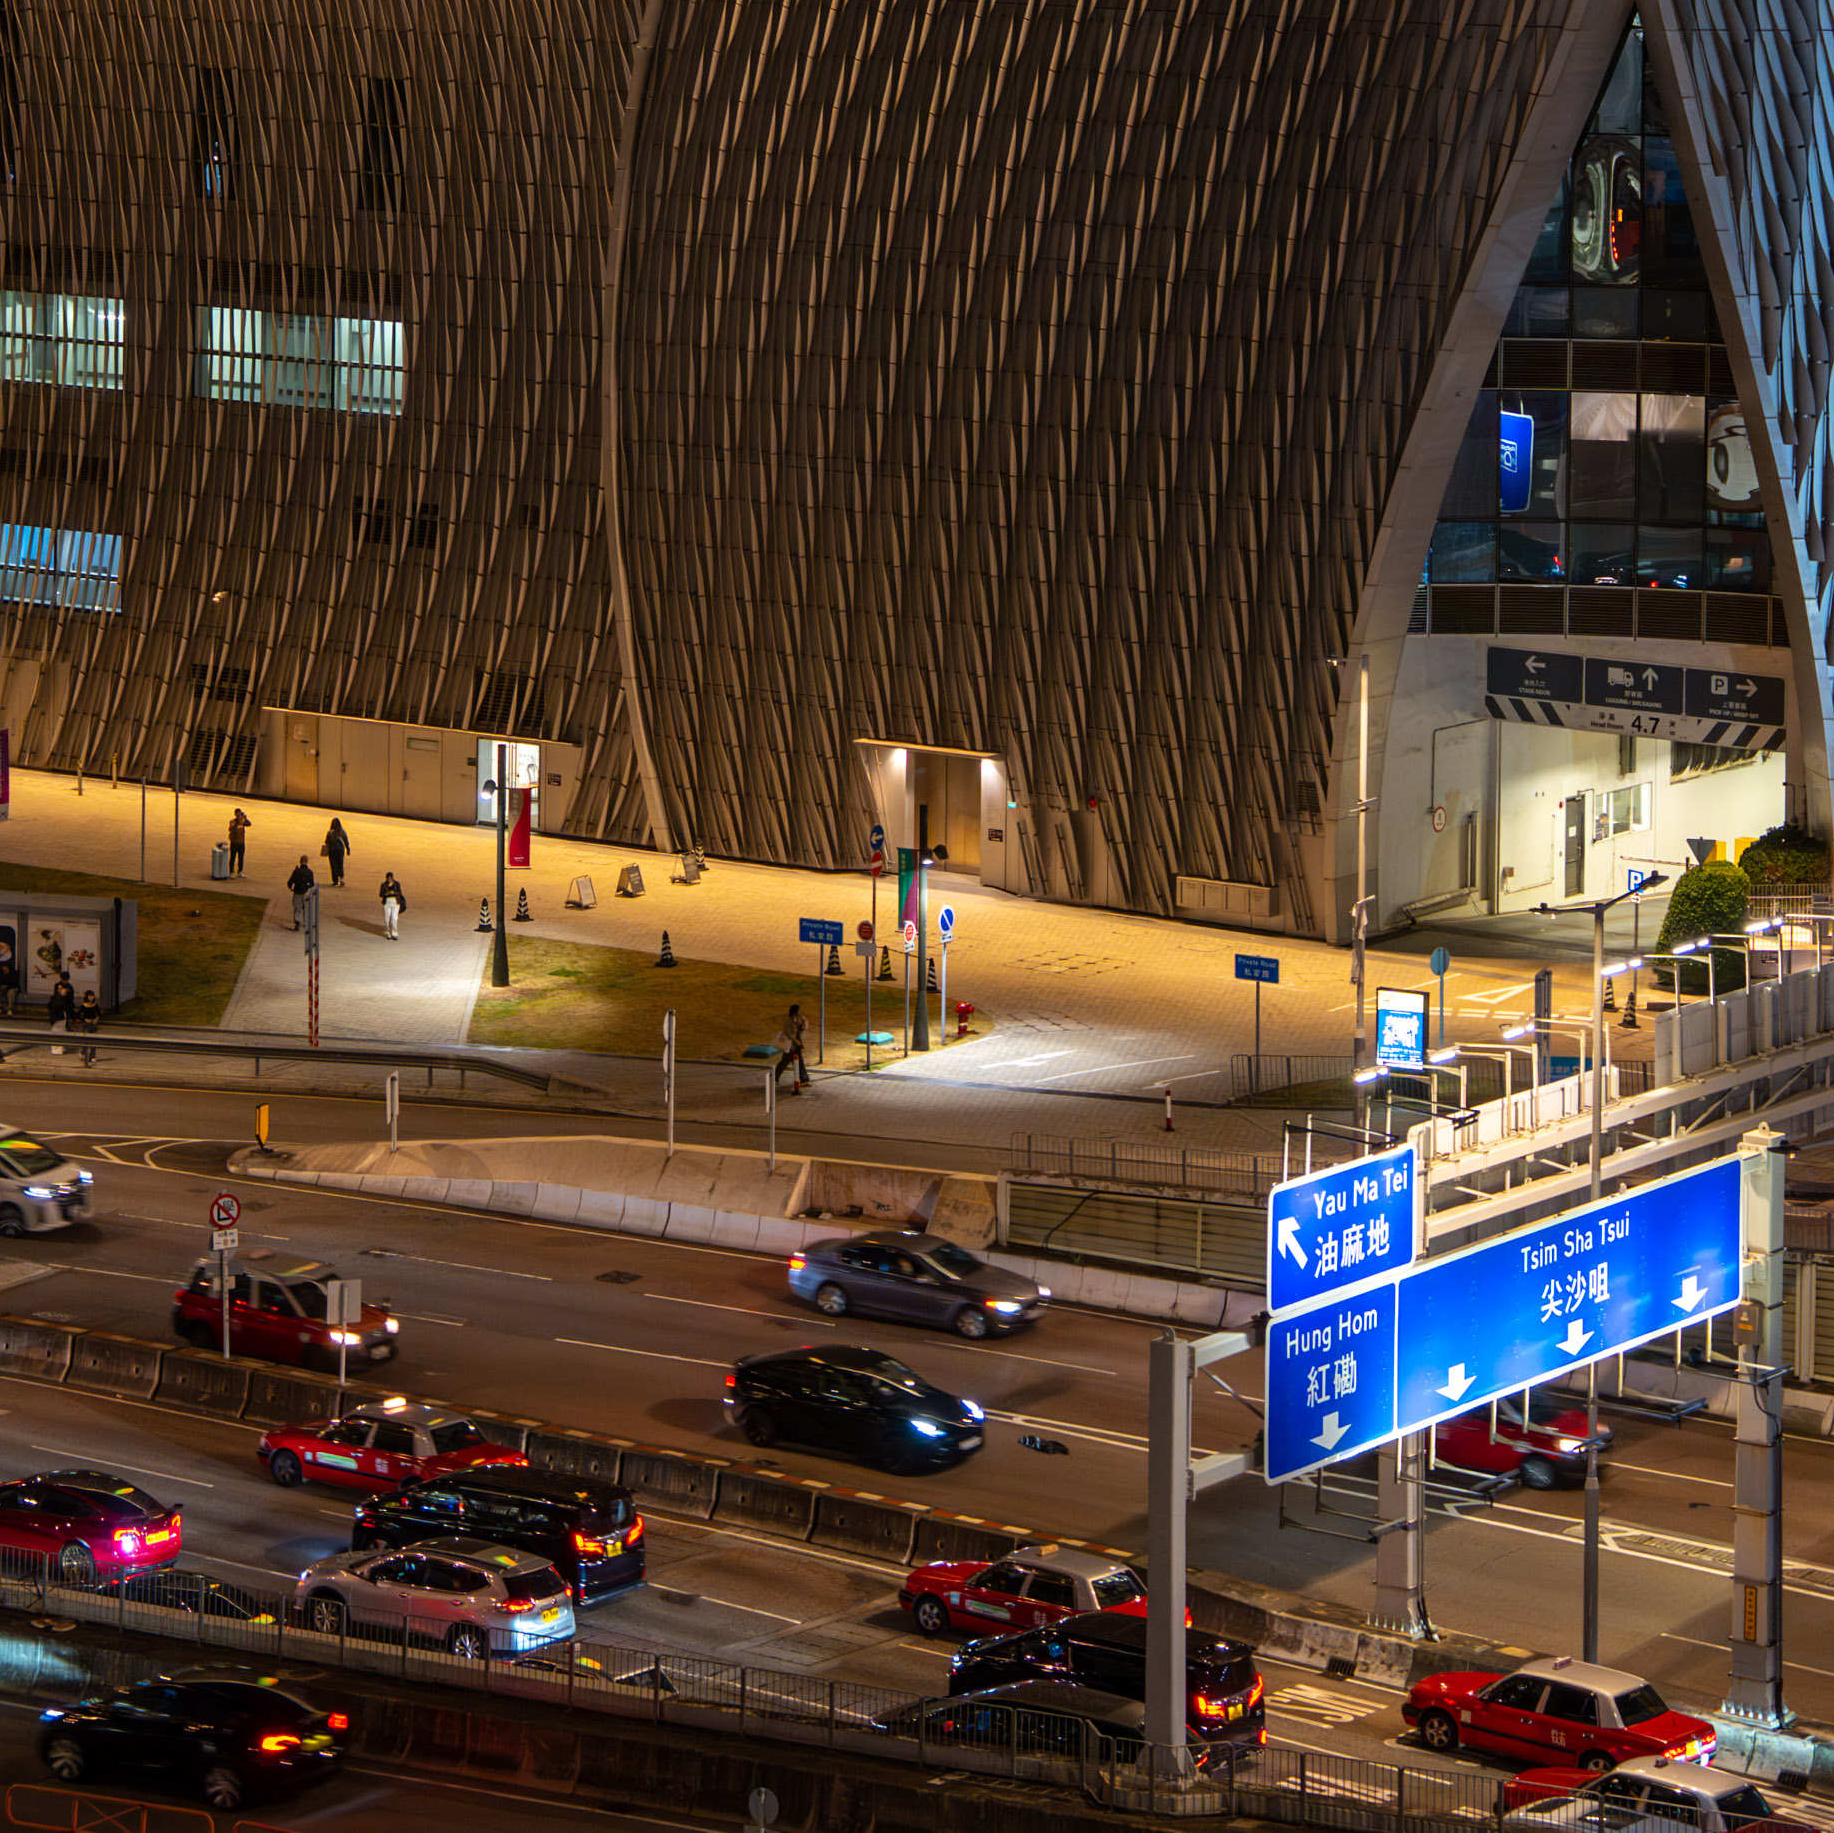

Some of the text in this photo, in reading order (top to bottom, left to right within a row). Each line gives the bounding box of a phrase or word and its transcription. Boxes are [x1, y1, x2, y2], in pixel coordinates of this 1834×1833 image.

[1590, 720, 1625, 731] Head Room
[1630, 715, 1661, 735] 4.7
[1237, 956, 1277, 968] Private Road
[1313, 1162, 1409, 1220] Yau Ma Tei
[1313, 1213, 1391, 1279] 油麻地
[1521, 1210, 1631, 1273] Tsim Sha Tsui
[1540, 1262, 1611, 1324] 尖沙咀
[1286, 1307, 1379, 1359] Hung Hom
[1305, 1351, 1358, 1409] 紅磡
